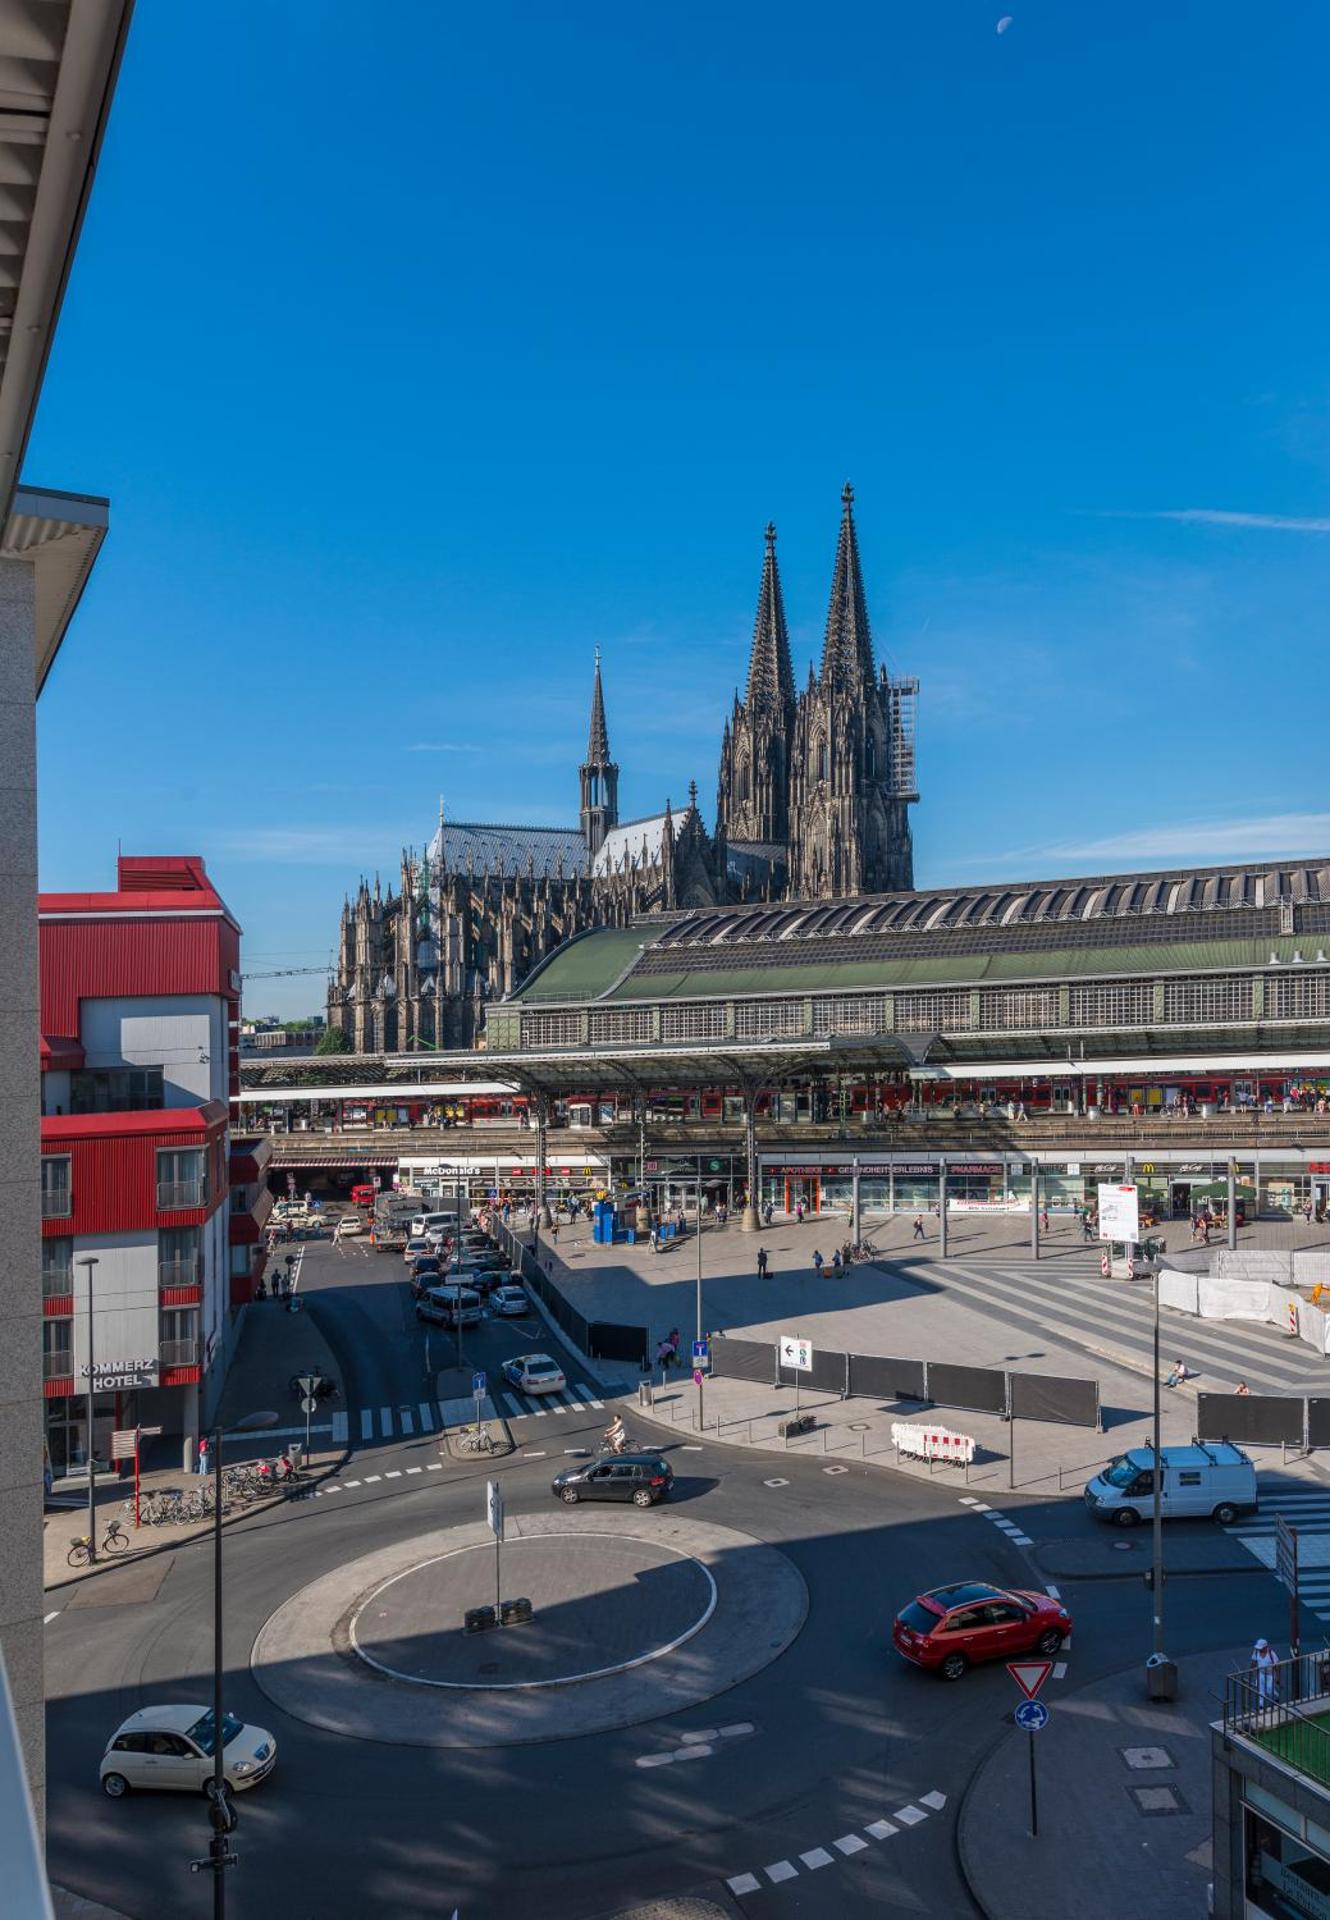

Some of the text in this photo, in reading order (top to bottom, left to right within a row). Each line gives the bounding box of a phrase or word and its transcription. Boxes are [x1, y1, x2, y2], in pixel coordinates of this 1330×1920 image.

[423, 1167, 481, 1176] McDonald's
[80, 1359, 154, 1375] KOMMERZ
[93, 1375, 142, 1388] HOTEL
